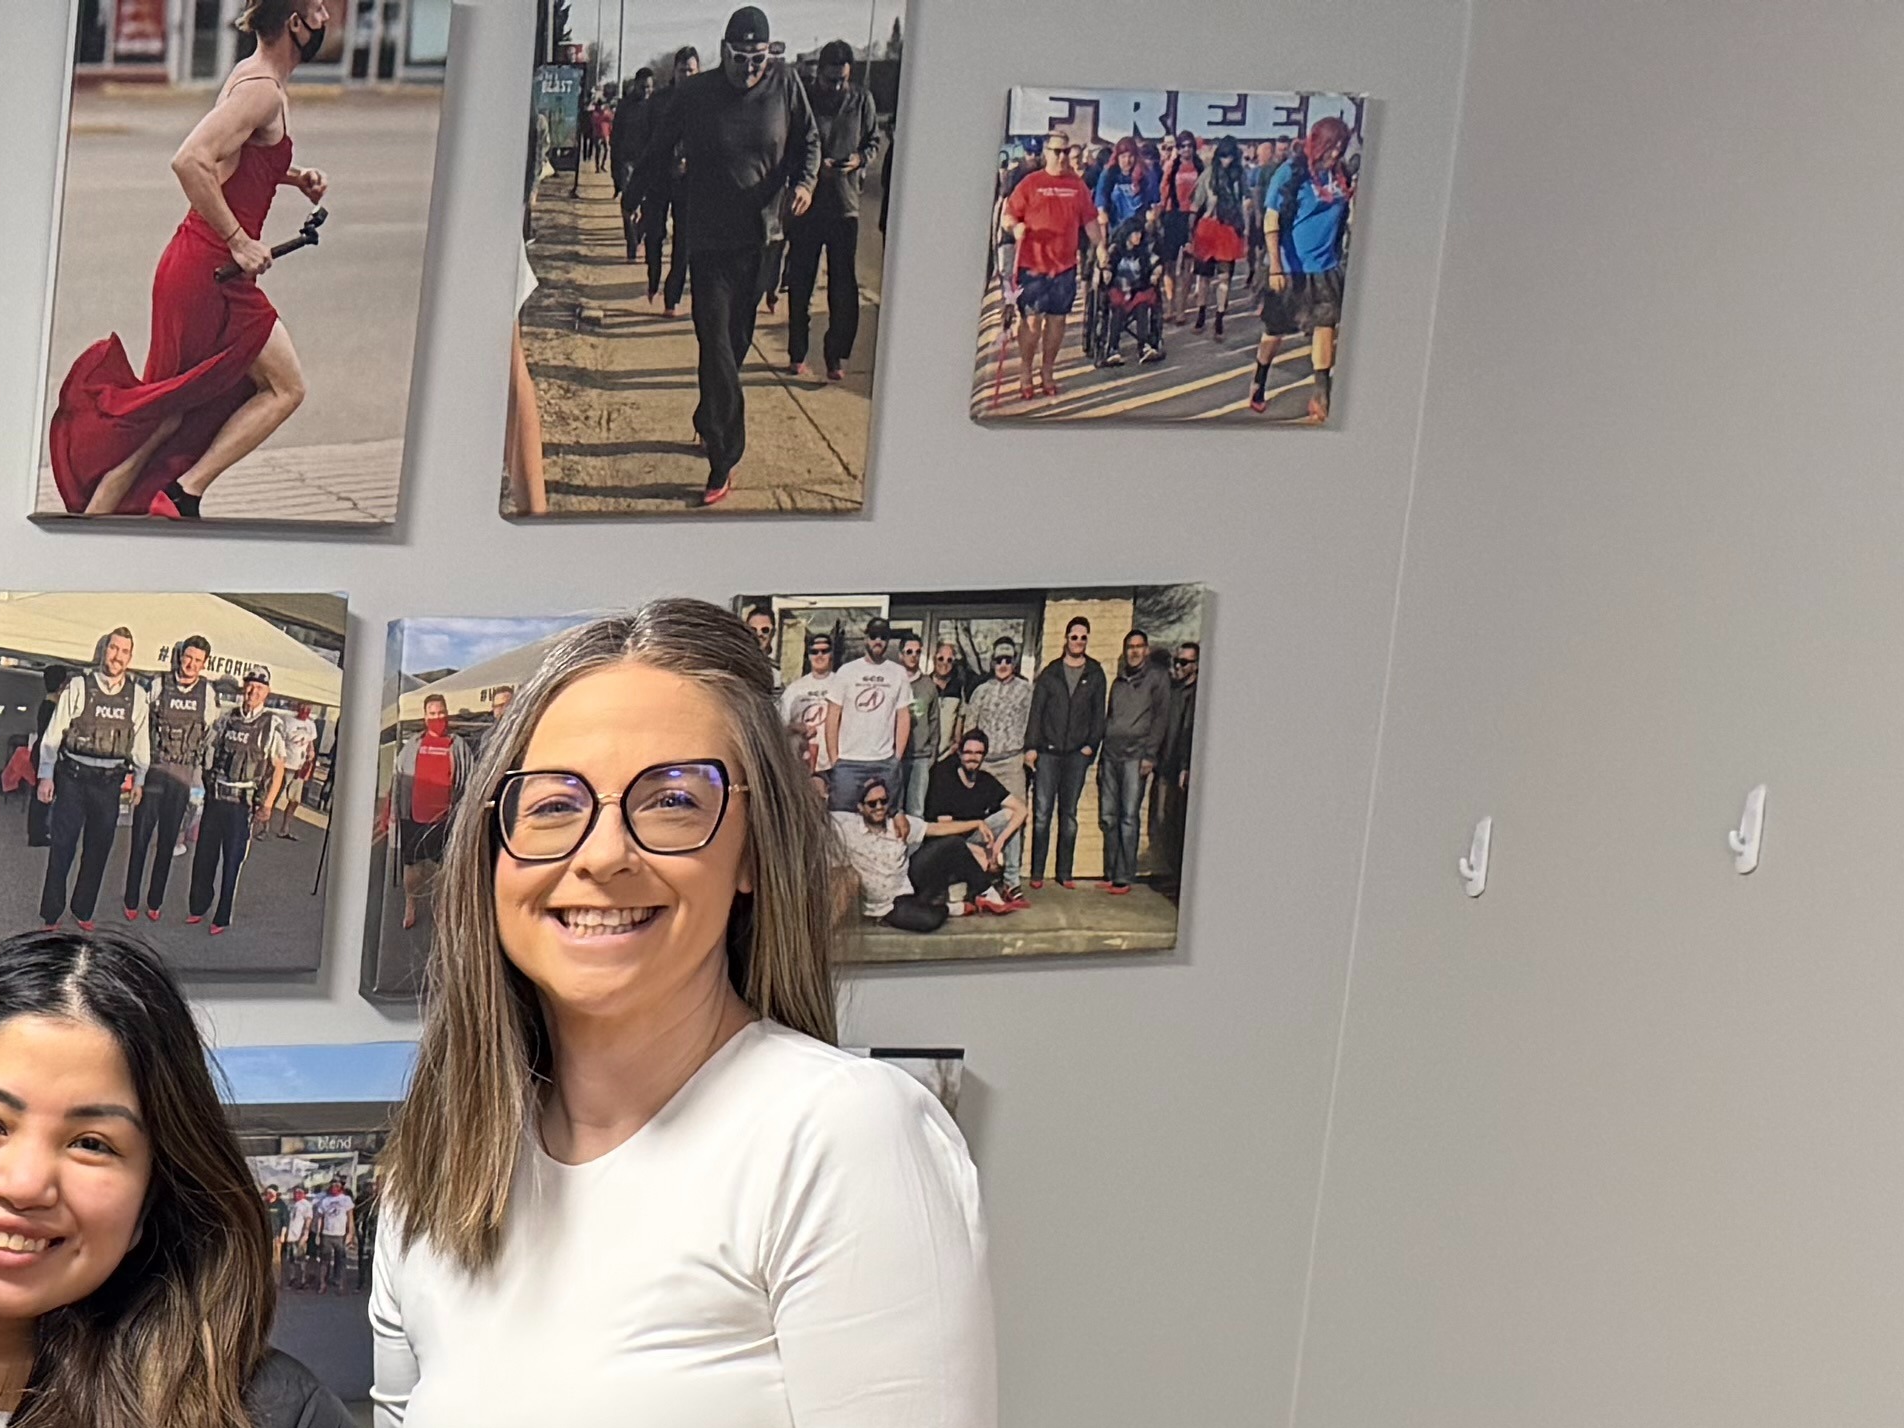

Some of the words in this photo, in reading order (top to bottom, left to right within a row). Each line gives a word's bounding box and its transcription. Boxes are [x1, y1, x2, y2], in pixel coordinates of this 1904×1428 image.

[170, 698, 197, 711] POLICE
[95, 706, 125, 720] POLICE
[225, 731, 250, 743] POLICE
[318, 1136, 352, 1150] blend
